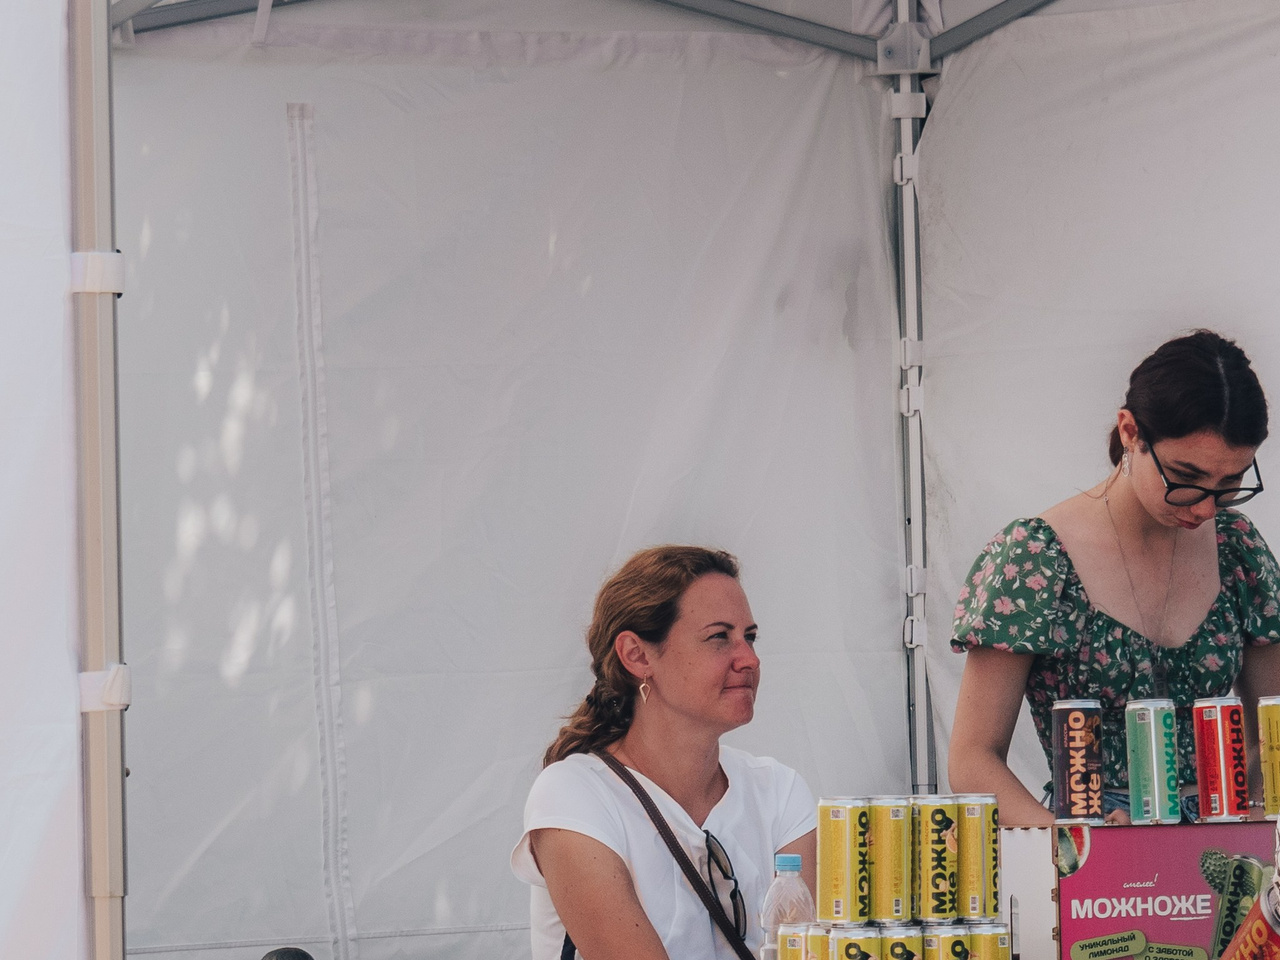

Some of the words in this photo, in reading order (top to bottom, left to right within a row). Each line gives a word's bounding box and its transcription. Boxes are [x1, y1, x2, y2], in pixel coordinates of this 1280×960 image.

[1068, 711, 1087, 815] МОЖНО
[1163, 712, 1180, 815] МОЖНО
[1230, 709, 1248, 811] МОЖНО
[931, 808, 948, 914] МОЖНО
[1071, 894, 1212, 919] МОЖНОЖЕ
[1079, 932, 1136, 951] УНИКАЛЬНЫЙ
[1088, 945, 1130, 959] ЛИМОНАД
[1156, 946, 1194, 957] ЗАБОТОЙ
